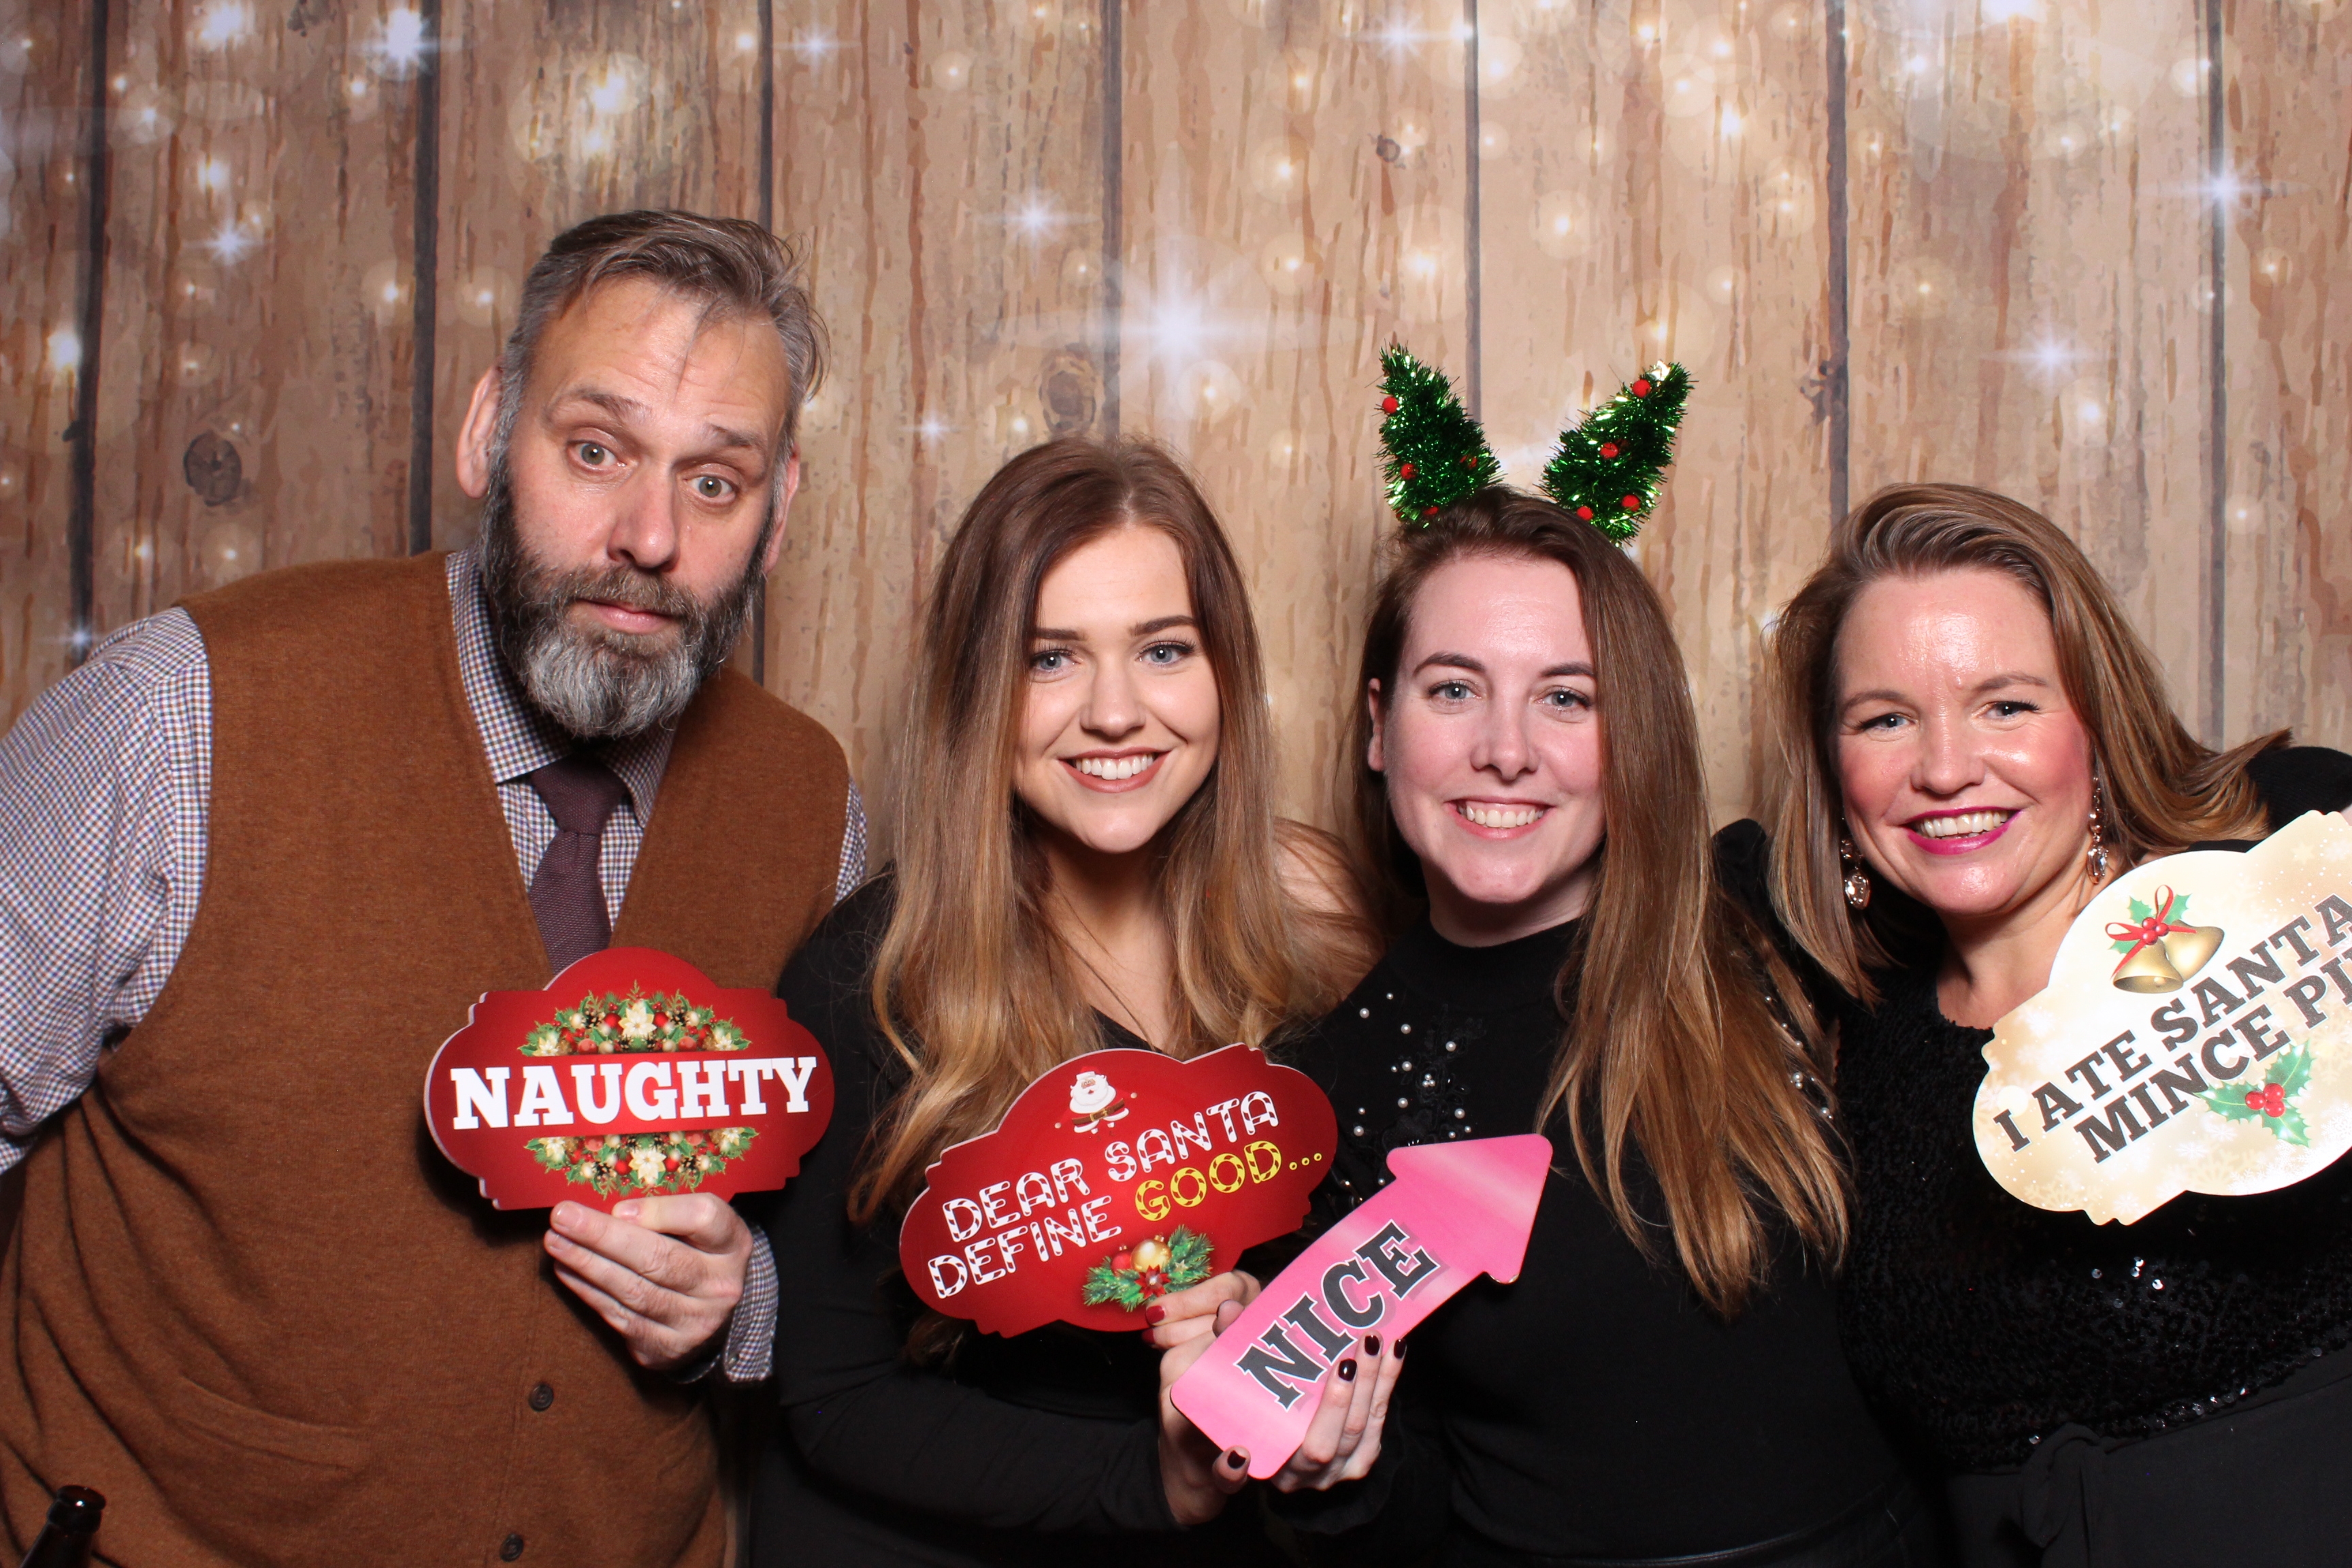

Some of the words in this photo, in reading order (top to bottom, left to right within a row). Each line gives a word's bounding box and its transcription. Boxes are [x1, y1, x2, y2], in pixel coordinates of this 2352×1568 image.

[450, 1056, 817, 1130] NAUGHTY
[1993, 1109, 2031, 1153] I
[2031, 1030, 2152, 1133] ATE
[2074, 1004, 2291, 1164] MINCE
[2283, 946, 2352, 1029] PI
[927, 1194, 1122, 1299] DEFINE
[1134, 1140, 1322, 1222] GOOD...
[943, 1158, 1090, 1243] DEAR
[1104, 1091, 1279, 1182] SANTA
[1234, 1219, 1440, 1412] NICE
